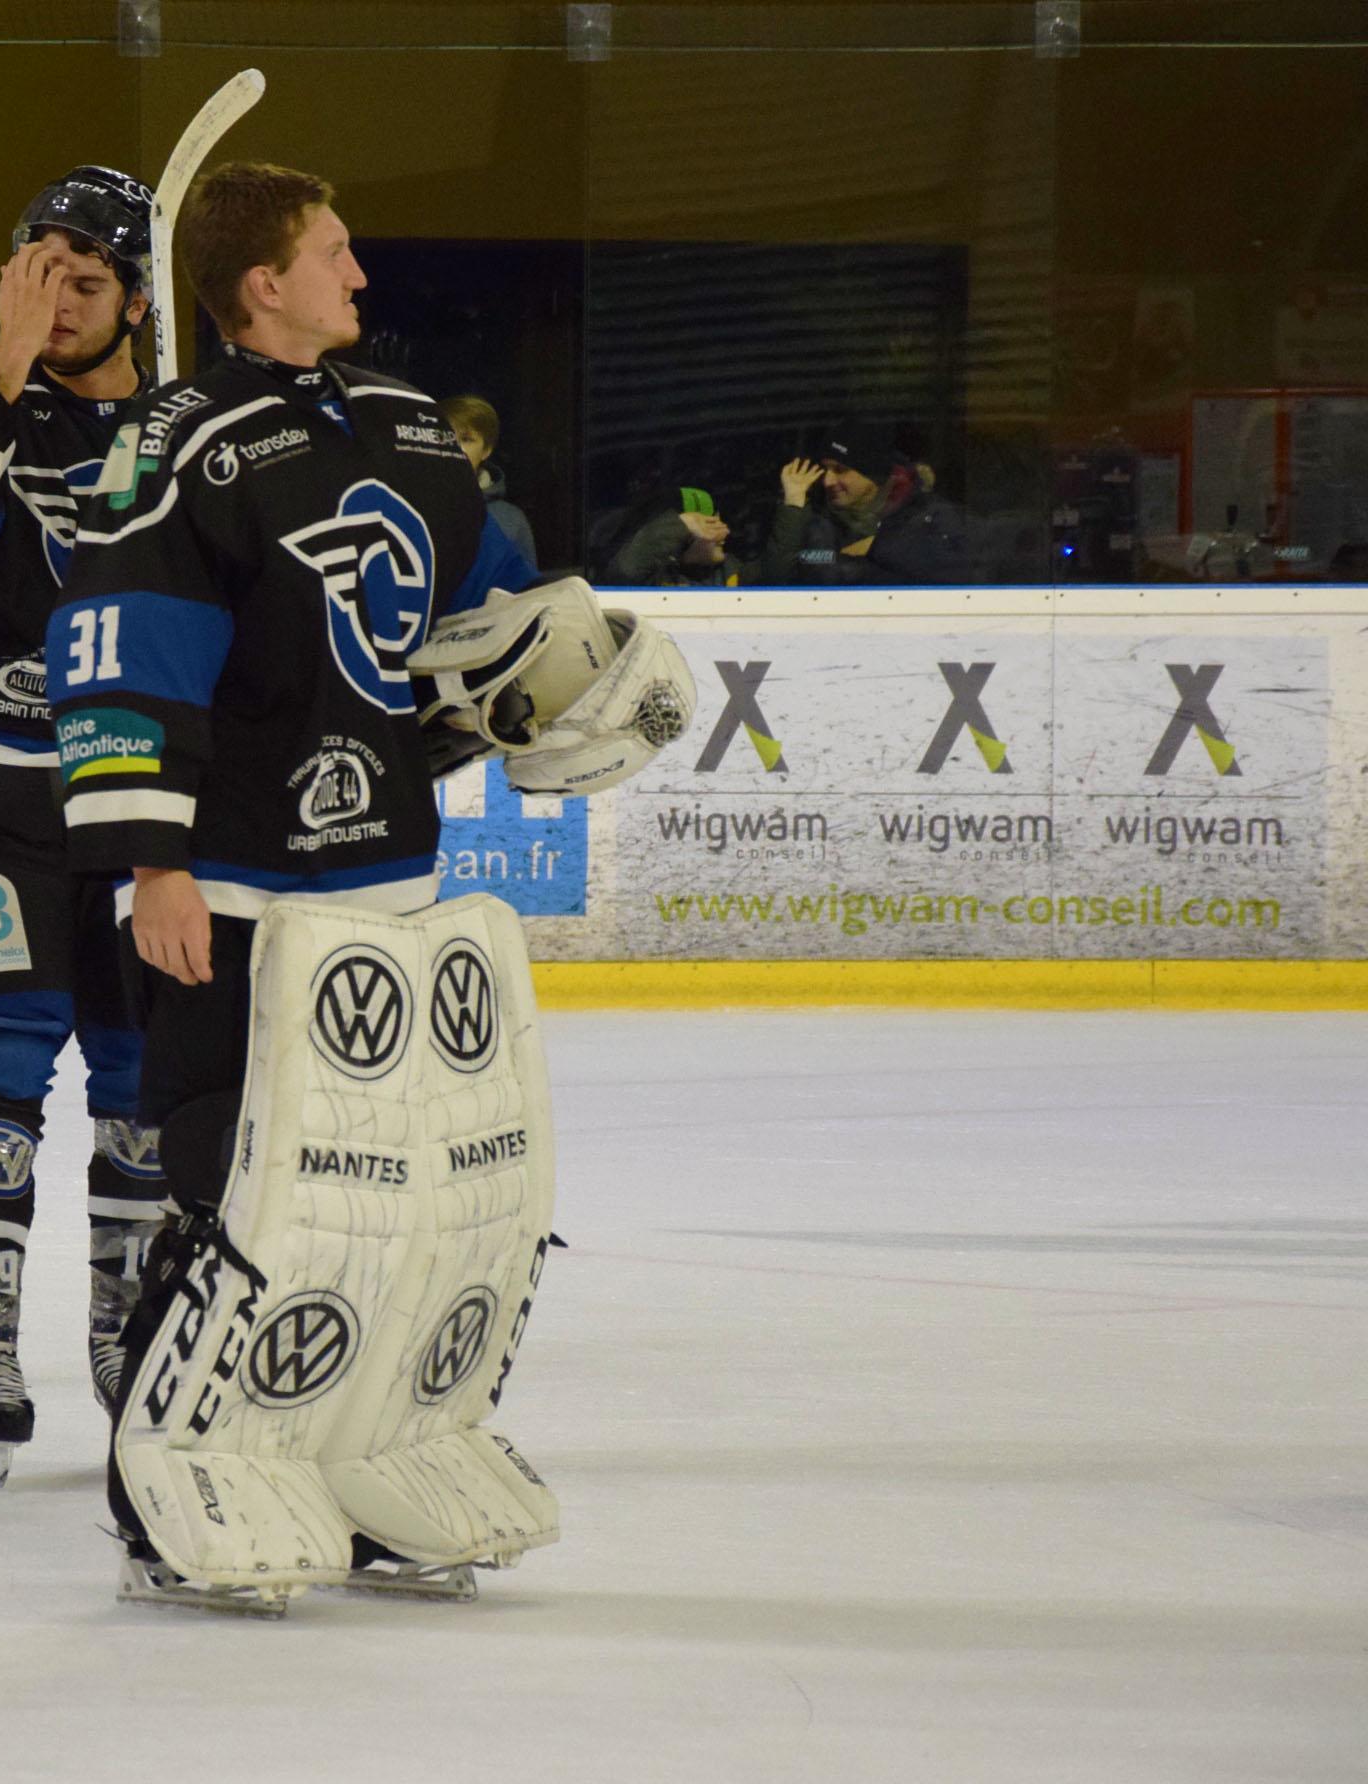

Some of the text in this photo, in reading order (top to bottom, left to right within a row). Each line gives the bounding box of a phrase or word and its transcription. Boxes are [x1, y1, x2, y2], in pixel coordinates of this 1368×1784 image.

[140, 387, 208, 456] BALLET
[240, 427, 309, 460] transdev
[66, 605, 122, 686] 31
[58, 718, 97, 743] Loire
[62, 733, 155, 764] Atlantique
[657, 803, 827, 854] wigwam
[879, 804, 1053, 853] wigwam
[1105, 806, 1284, 857] wigwam
[735, 845, 827, 861] conseil
[958, 847, 1054, 863] conseil
[1186, 849, 1283, 865] conseil
[653, 882, 1283, 937] www.wigwam-conseil.com
[300, 1147, 409, 1186] NANTES
[449, 1130, 527, 1173] NANTES
[187, 1262, 269, 1437] CCM
